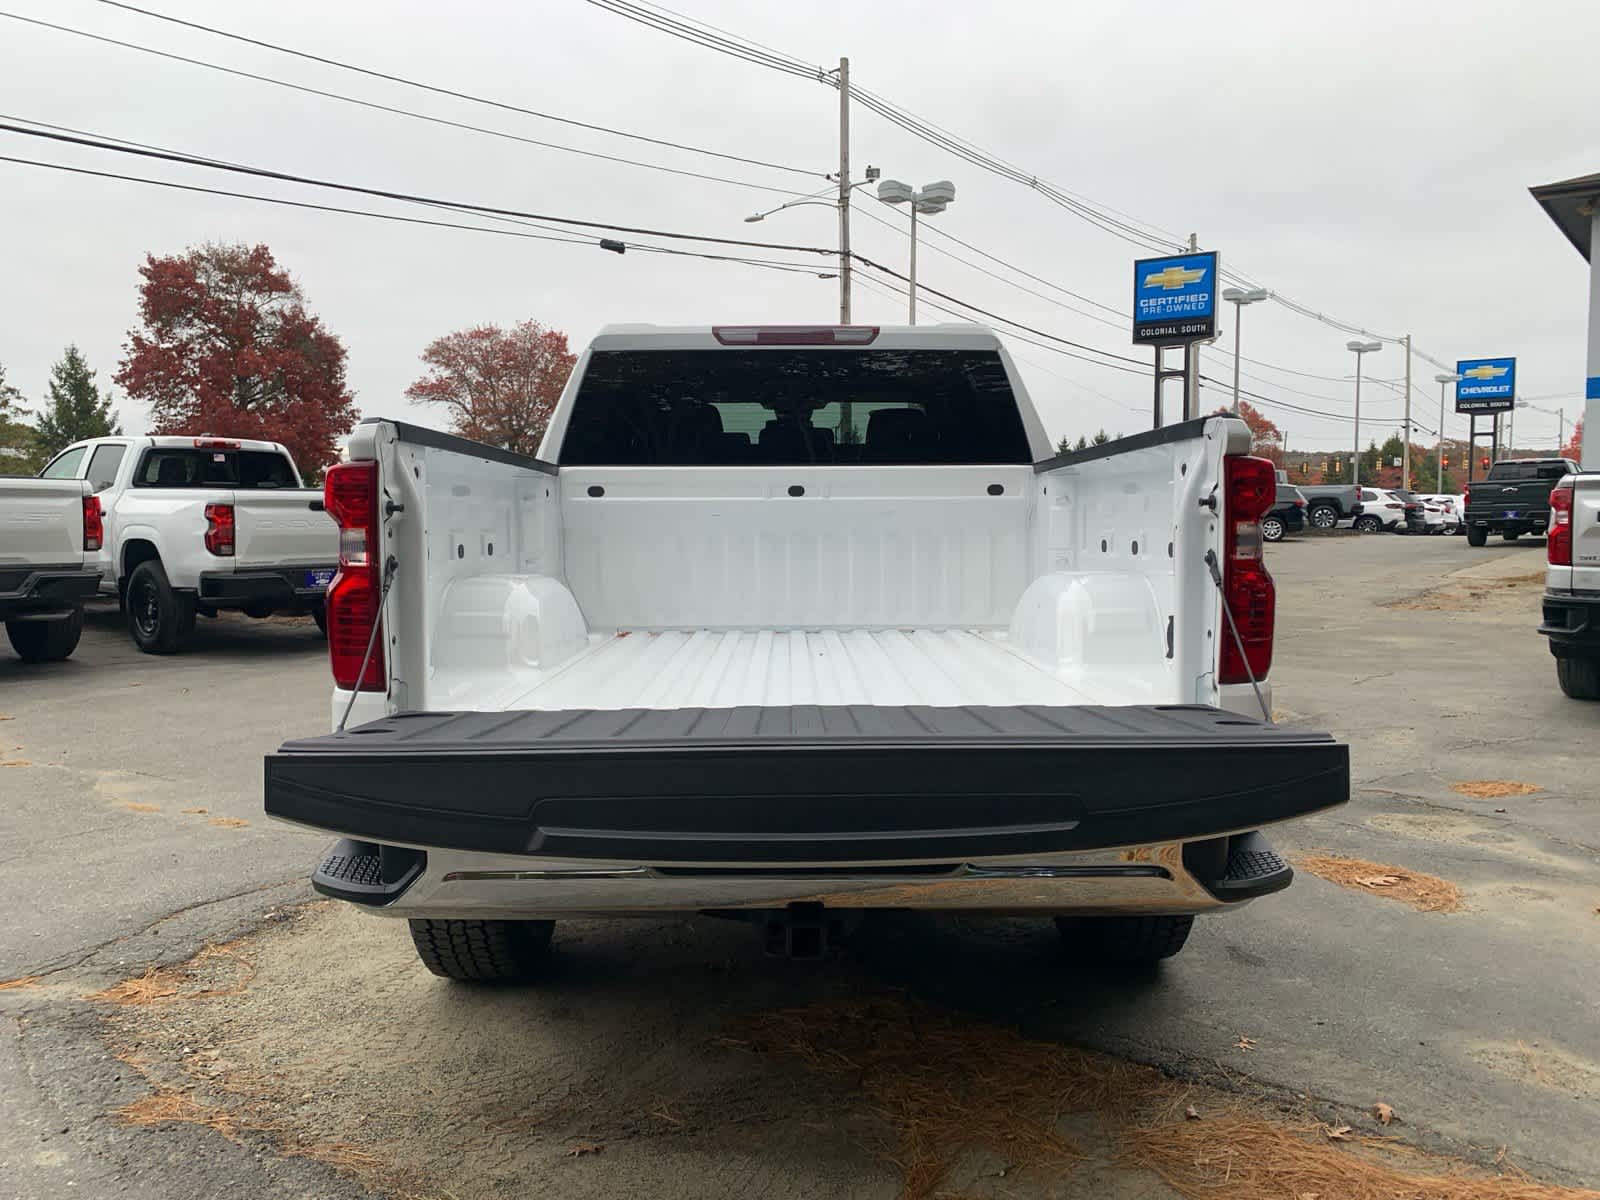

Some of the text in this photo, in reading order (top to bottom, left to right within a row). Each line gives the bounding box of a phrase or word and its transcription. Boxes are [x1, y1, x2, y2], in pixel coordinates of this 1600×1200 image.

[1140, 293, 1209, 308] CERTIFIED
[1143, 302, 1205, 315] PRE-OWNED
[1141, 324, 1206, 336] COLONIAL SOUTH
[1460, 385, 1510, 394] CHEVROLET
